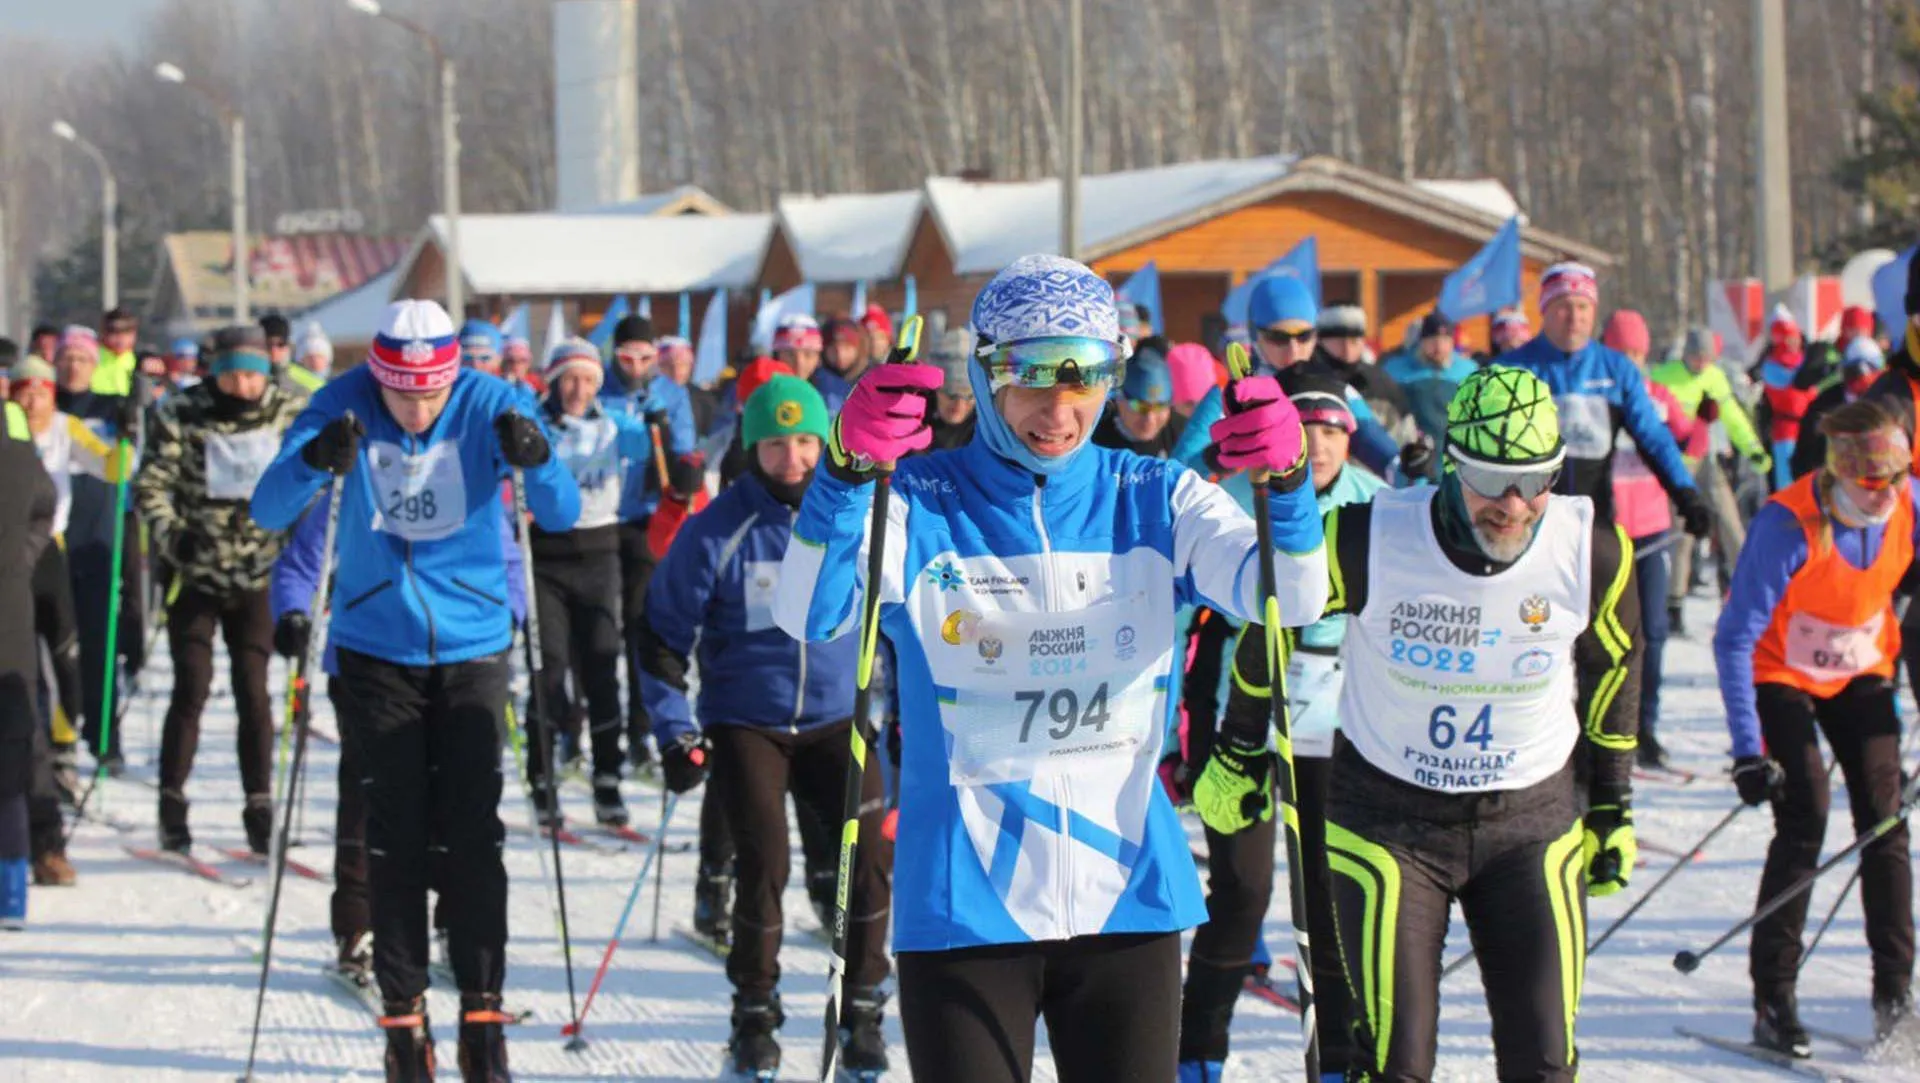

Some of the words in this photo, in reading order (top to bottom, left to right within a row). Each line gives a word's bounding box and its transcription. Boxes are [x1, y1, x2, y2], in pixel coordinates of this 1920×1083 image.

[387, 489, 437, 522] 298
[1390, 602, 1482, 625] ЛЫЖНЯ
[1028, 625, 1085, 642] ЛЫЖНЯ
[1390, 618, 1480, 647] РОССИИ
[1029, 639, 1086, 656] РОССИИ
[1390, 639, 1476, 673] 2022
[1029, 656, 1087, 676] 2024
[1014, 682, 1111, 743] 794
[1428, 703, 1494, 751] 64
